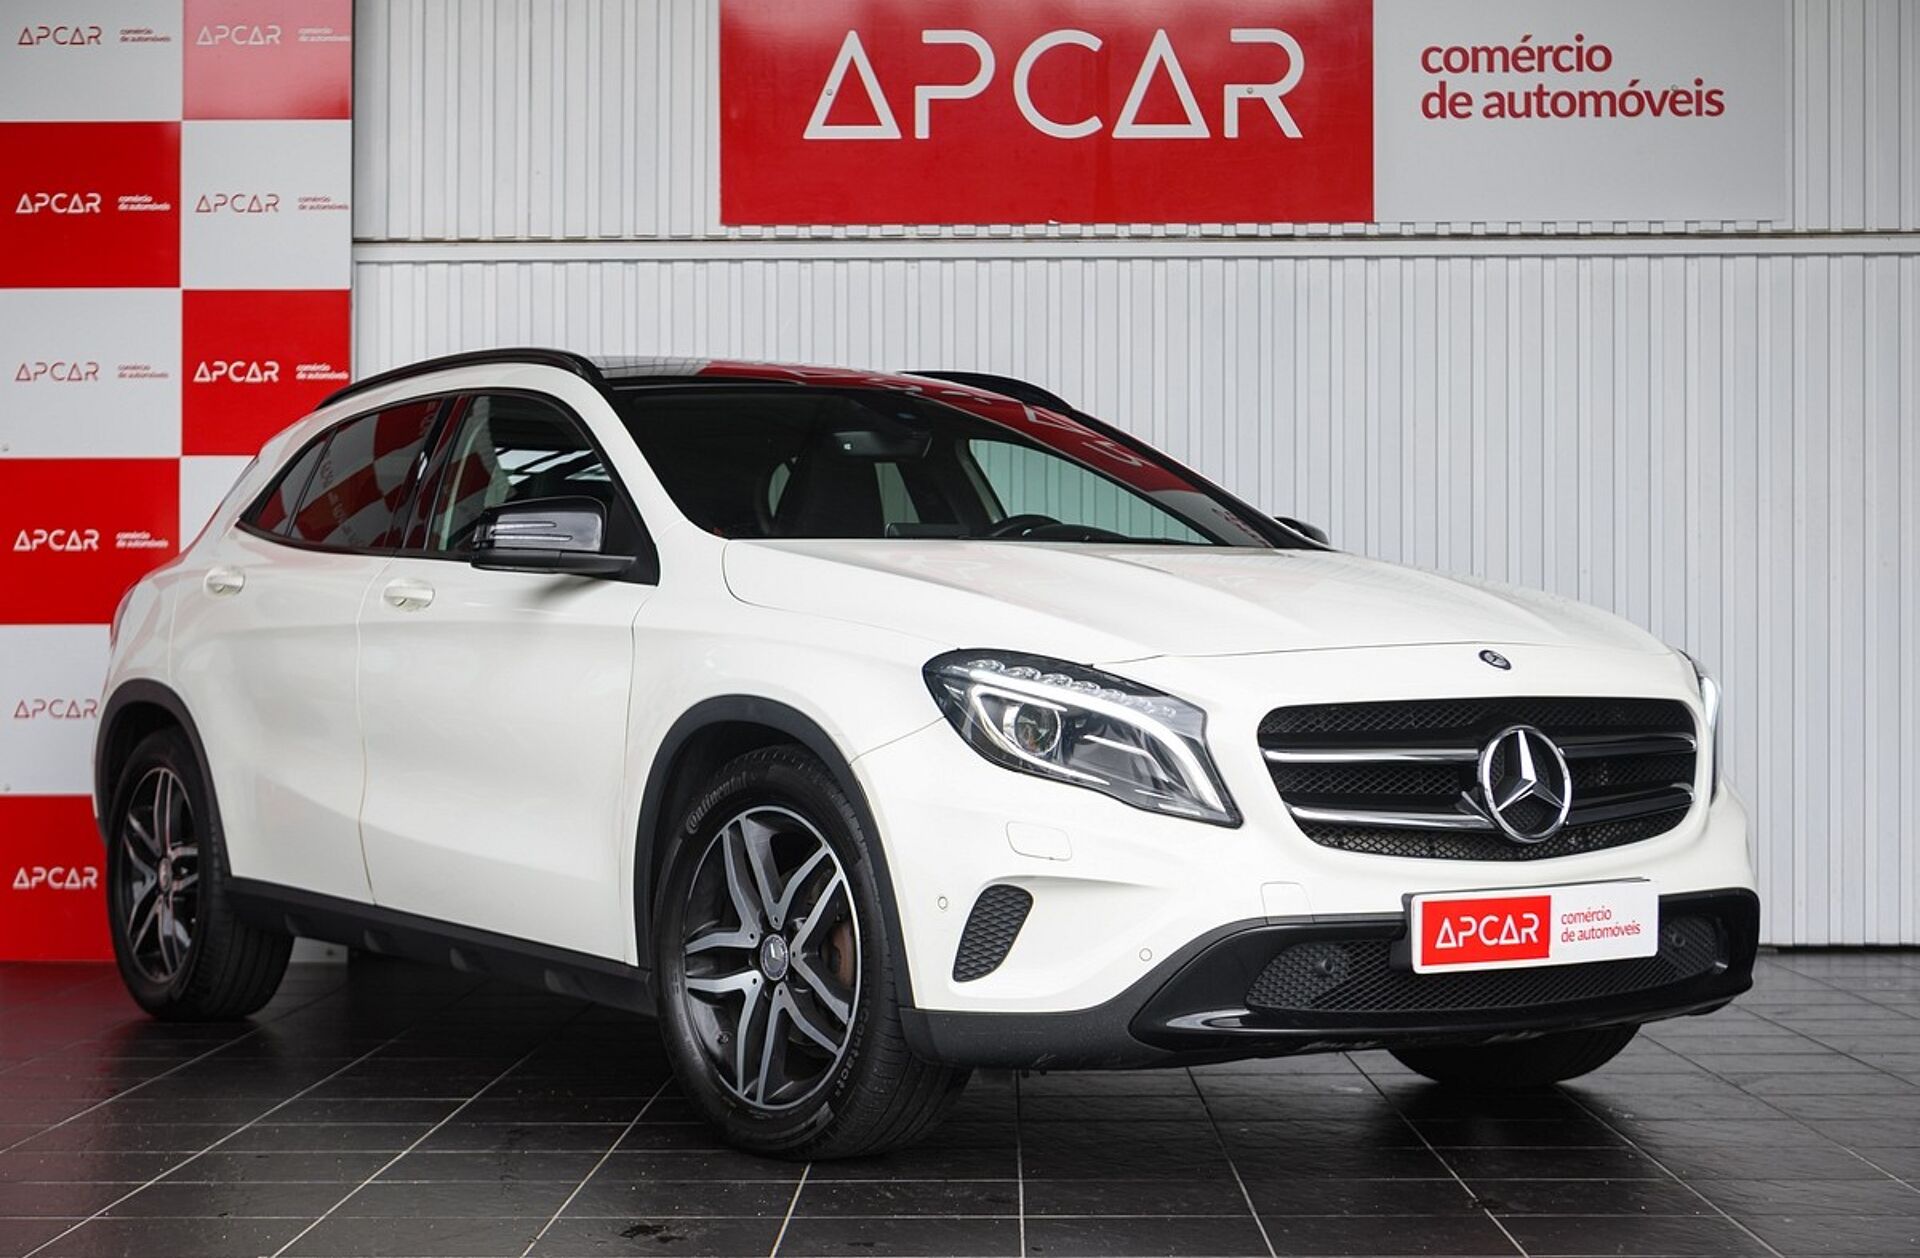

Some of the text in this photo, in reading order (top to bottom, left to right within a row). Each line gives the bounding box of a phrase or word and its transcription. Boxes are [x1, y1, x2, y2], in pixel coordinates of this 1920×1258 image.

[18, 25, 101, 45] APCAR
[196, 25, 281, 45] APCAR
[1421, 34, 1612, 74] comércio
[803, 28, 1305, 139] APCAR
[1421, 78, 1726, 119] de automóveis
[16, 193, 101, 214] APCAR
[195, 193, 279, 213] APCAR
[15, 361, 99, 382] APCAR
[193, 361, 280, 383] APCAR
[13, 528, 99, 551] APCAR
[14, 699, 97, 719] APCAR
[12, 866, 98, 889] APCAR
[1561, 906, 1612, 925] comércio
[1435, 912, 1540, 949] APCAR
[1561, 920, 1641, 943] de automóveis
